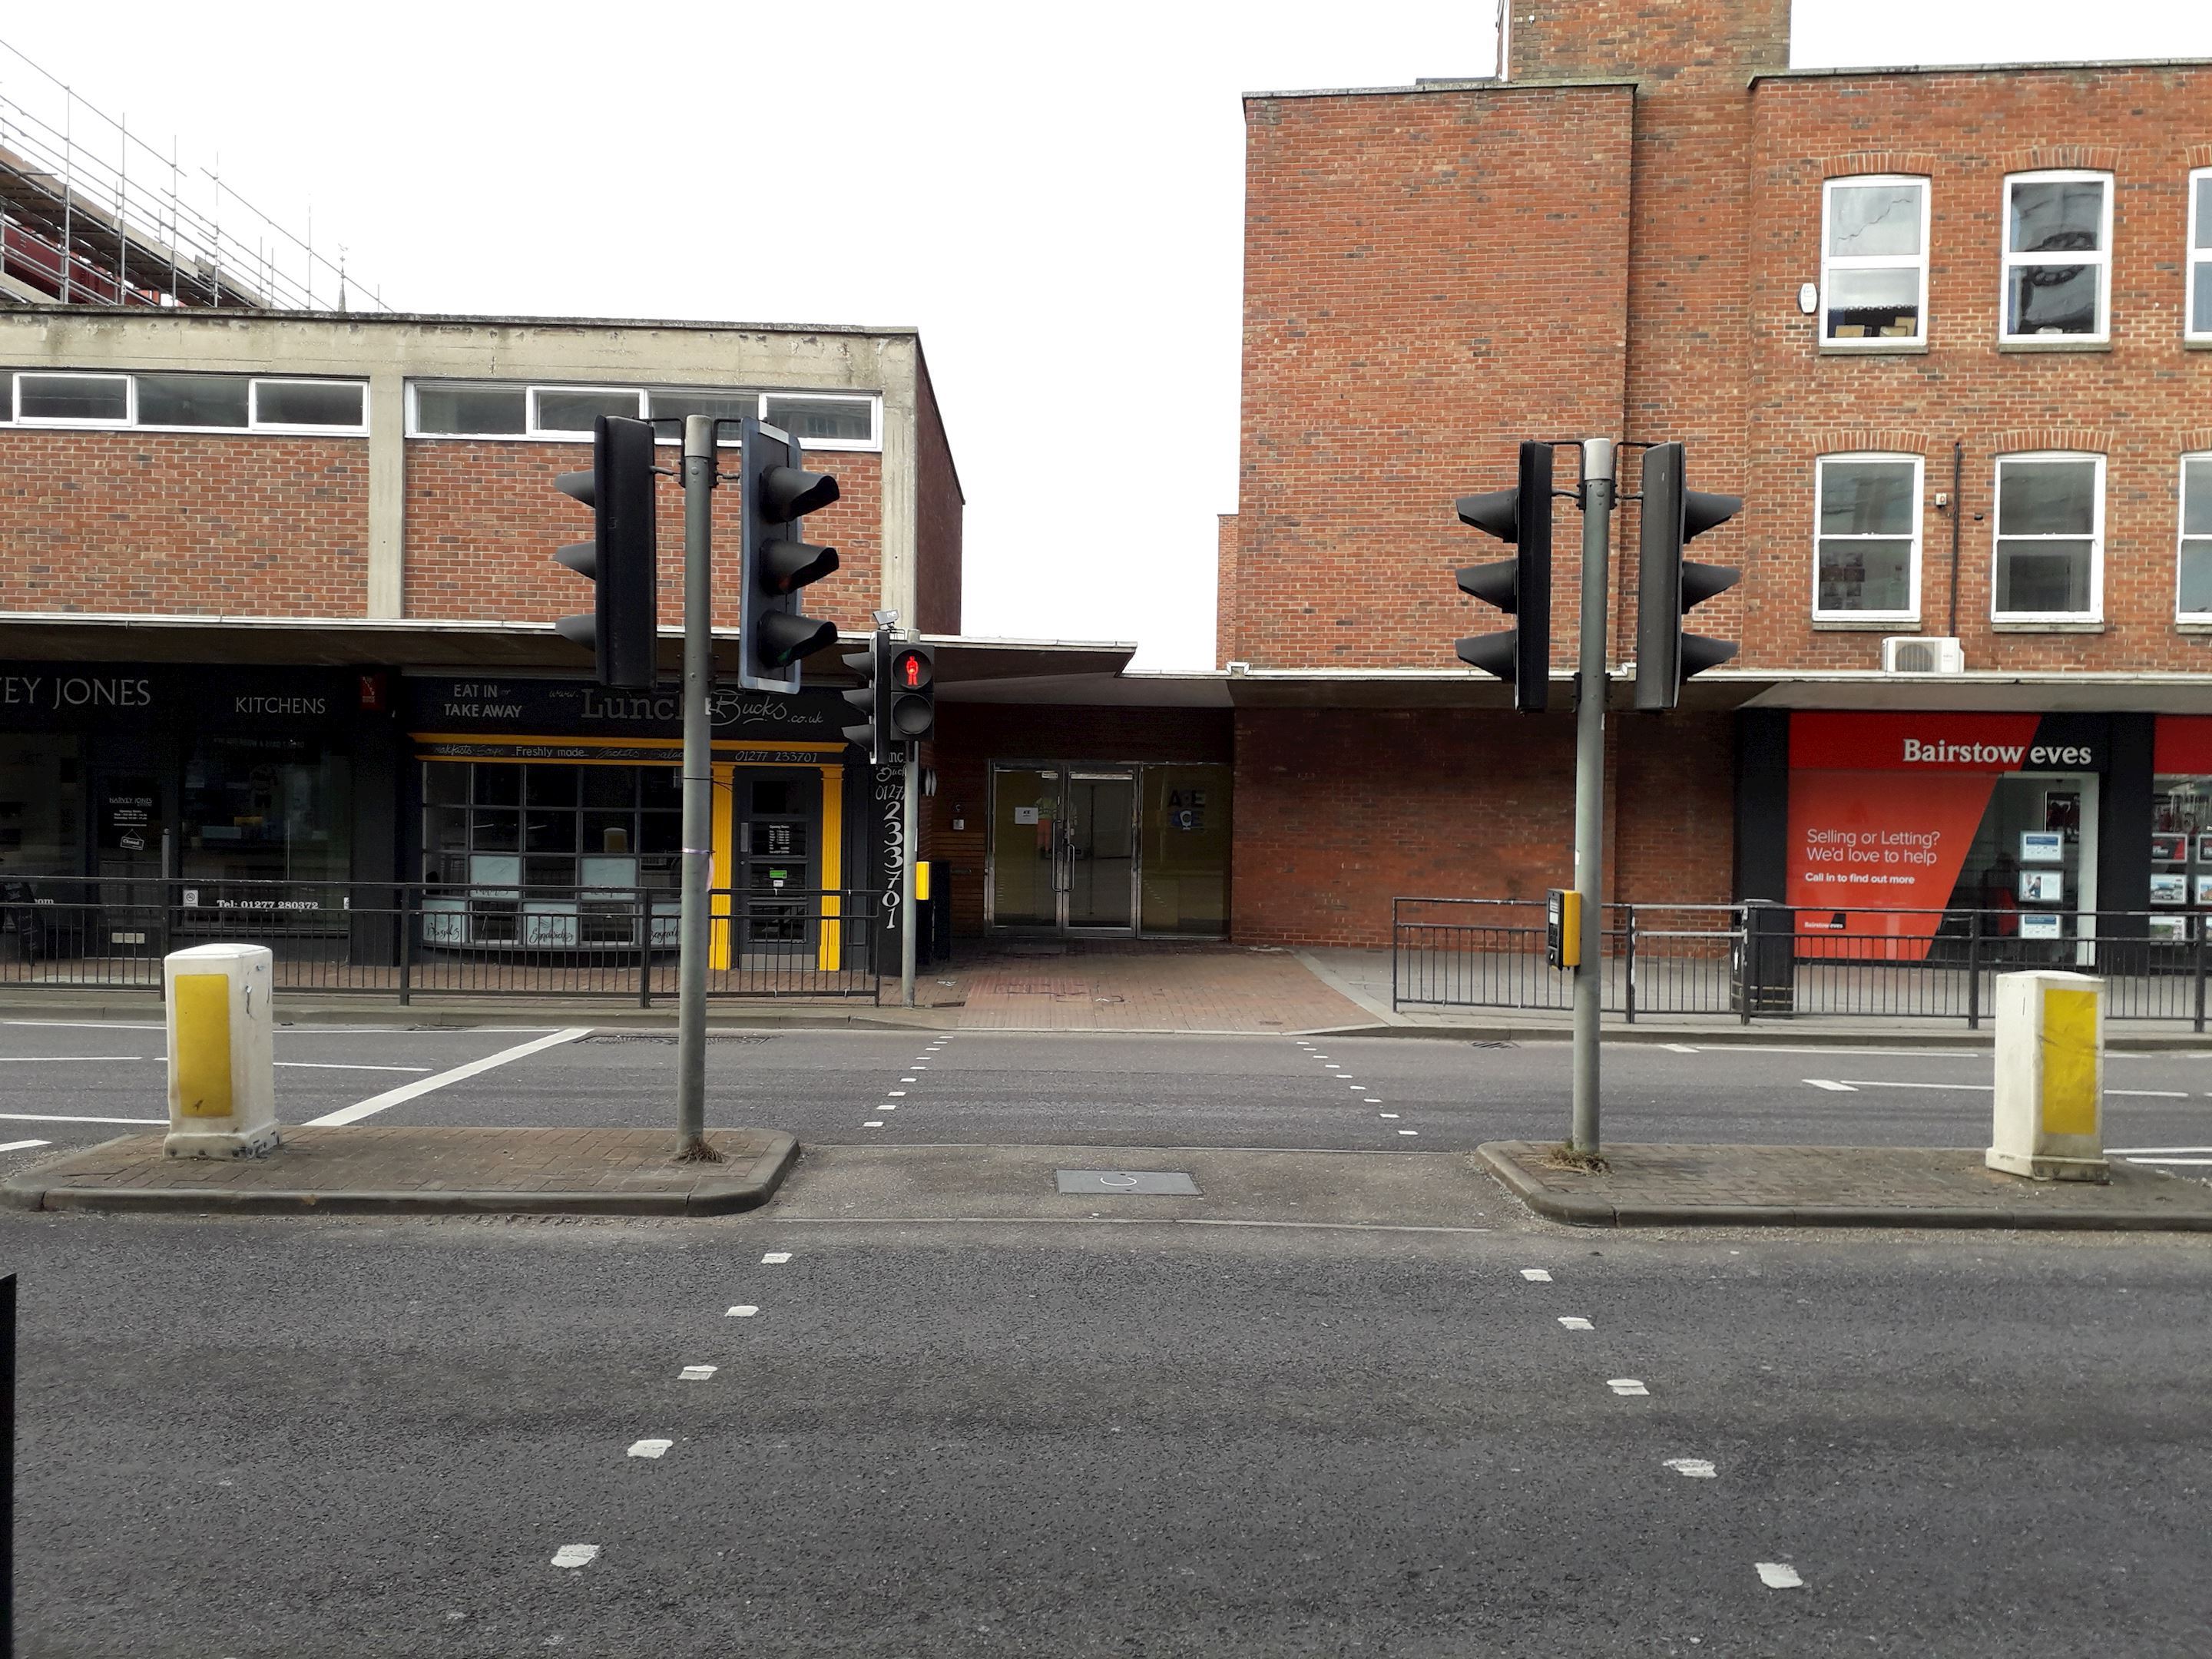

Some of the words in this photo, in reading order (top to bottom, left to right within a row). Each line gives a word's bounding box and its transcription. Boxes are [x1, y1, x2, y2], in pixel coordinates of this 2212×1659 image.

[0, 677, 41, 704] EY
[52, 677, 151, 710] JONES
[454, 684, 479, 697] EAT
[484, 684, 498, 698] IN
[235, 697, 326, 714] KITCHENS
[443, 704, 479, 717] TAKE
[482, 704, 522, 718] AWAY
[709, 689, 787, 726] Bucks
[515, 746, 552, 757] Freshly
[735, 751, 768, 761] 01277
[774, 752, 818, 763] 233701
[1902, 739, 2025, 763] Bairstow
[2029, 746, 2092, 765] eves
[1806, 829, 1856, 848] Selling
[1861, 833, 1877, 845] or
[1881, 831, 1940, 849] Letting?
[1806, 847, 1844, 862] We'd
[1849, 848, 1880, 863] love
[1884, 849, 1899, 863] to
[1904, 849, 1937, 866] help
[1805, 873, 1823, 882] Call
[1826, 873, 1835, 882] in
[1837, 873, 1847, 882] to
[1849, 873, 1869, 882] find
[1870, 875, 1887, 883] out
[1889, 876, 1915, 884] more
[216, 899, 239, 909] Tel:
[240, 900, 274, 909] 01277
[277, 902, 320, 910] 280372
